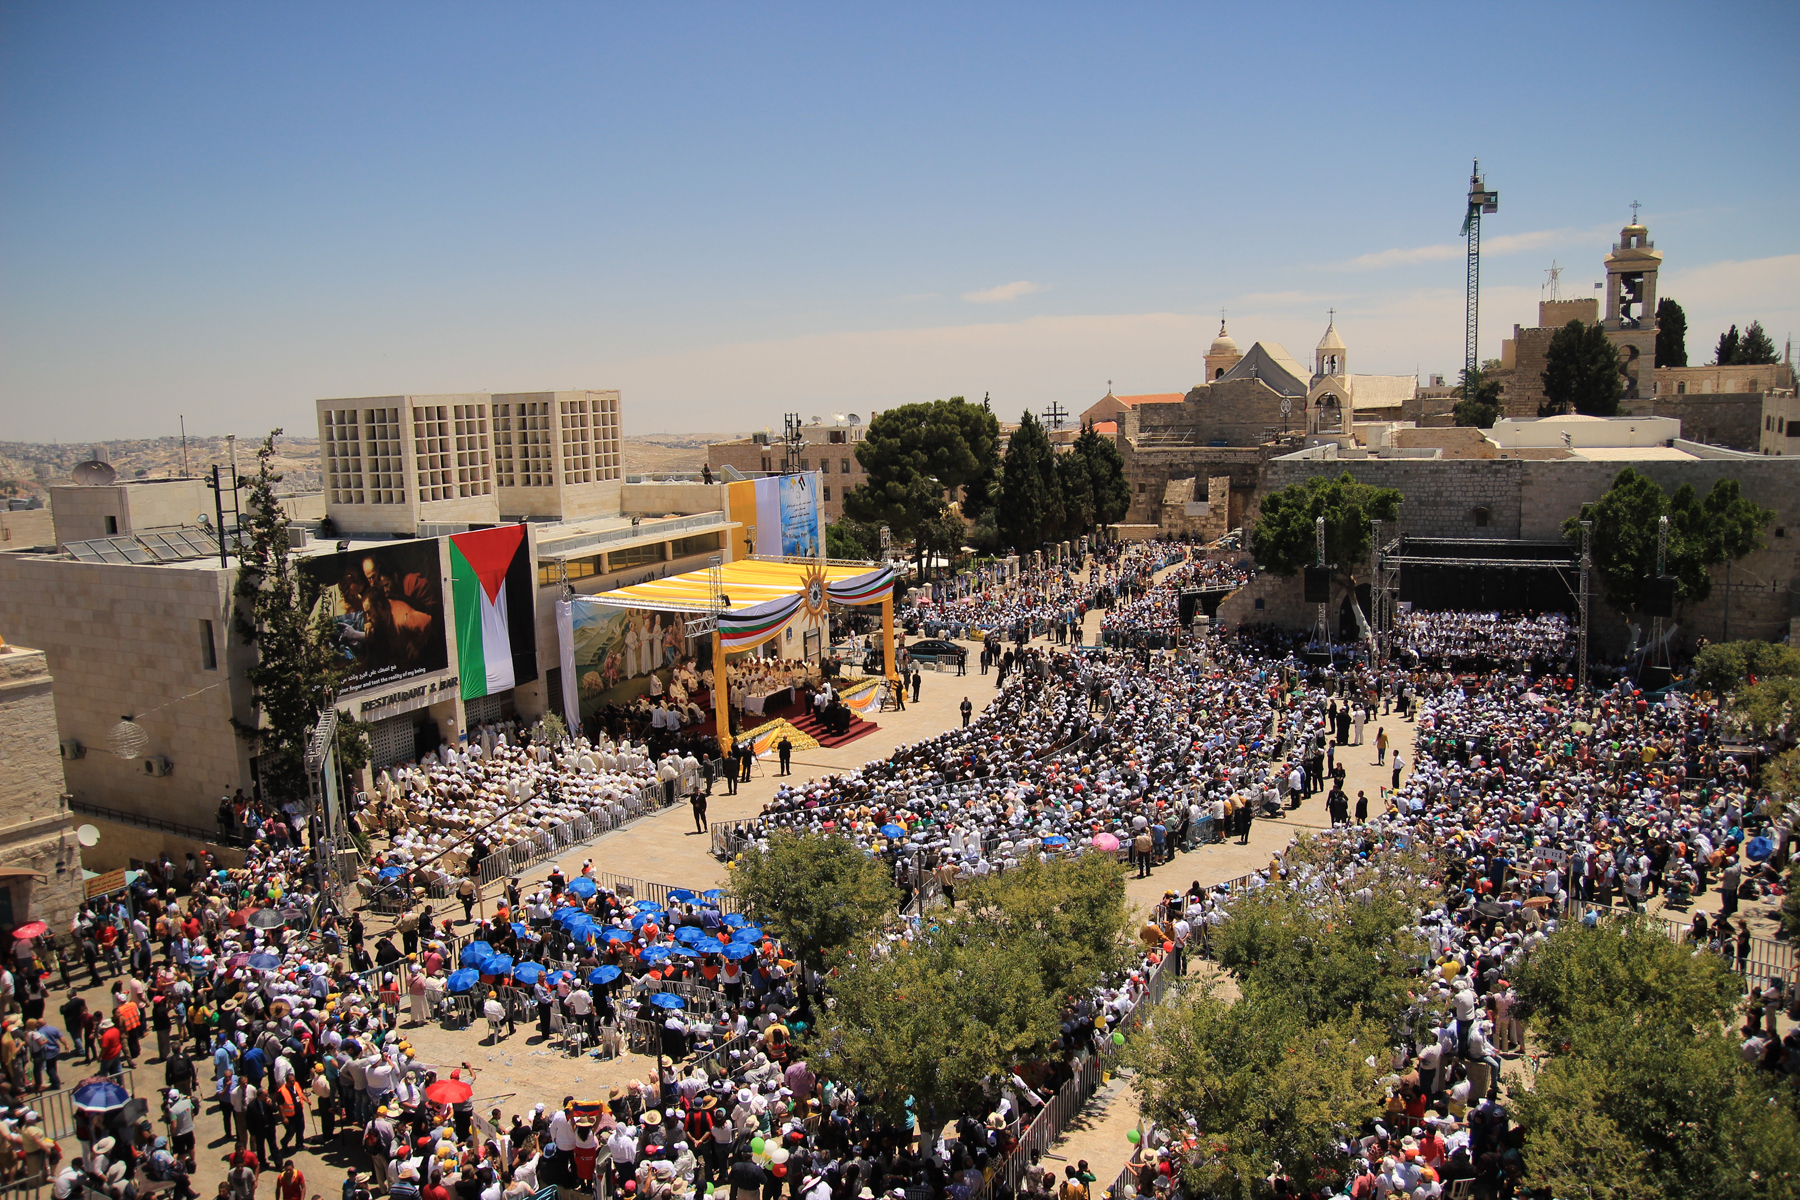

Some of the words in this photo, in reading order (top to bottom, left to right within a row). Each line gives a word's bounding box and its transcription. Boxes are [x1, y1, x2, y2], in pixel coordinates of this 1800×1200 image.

[349, 684, 362, 694] finger
[388, 672, 403, 681] reality
[414, 666, 426, 675] being
[361, 685, 427, 712] RESTAURANT
[429, 682, 437, 693] &
[439, 676, 458, 690] BAR
